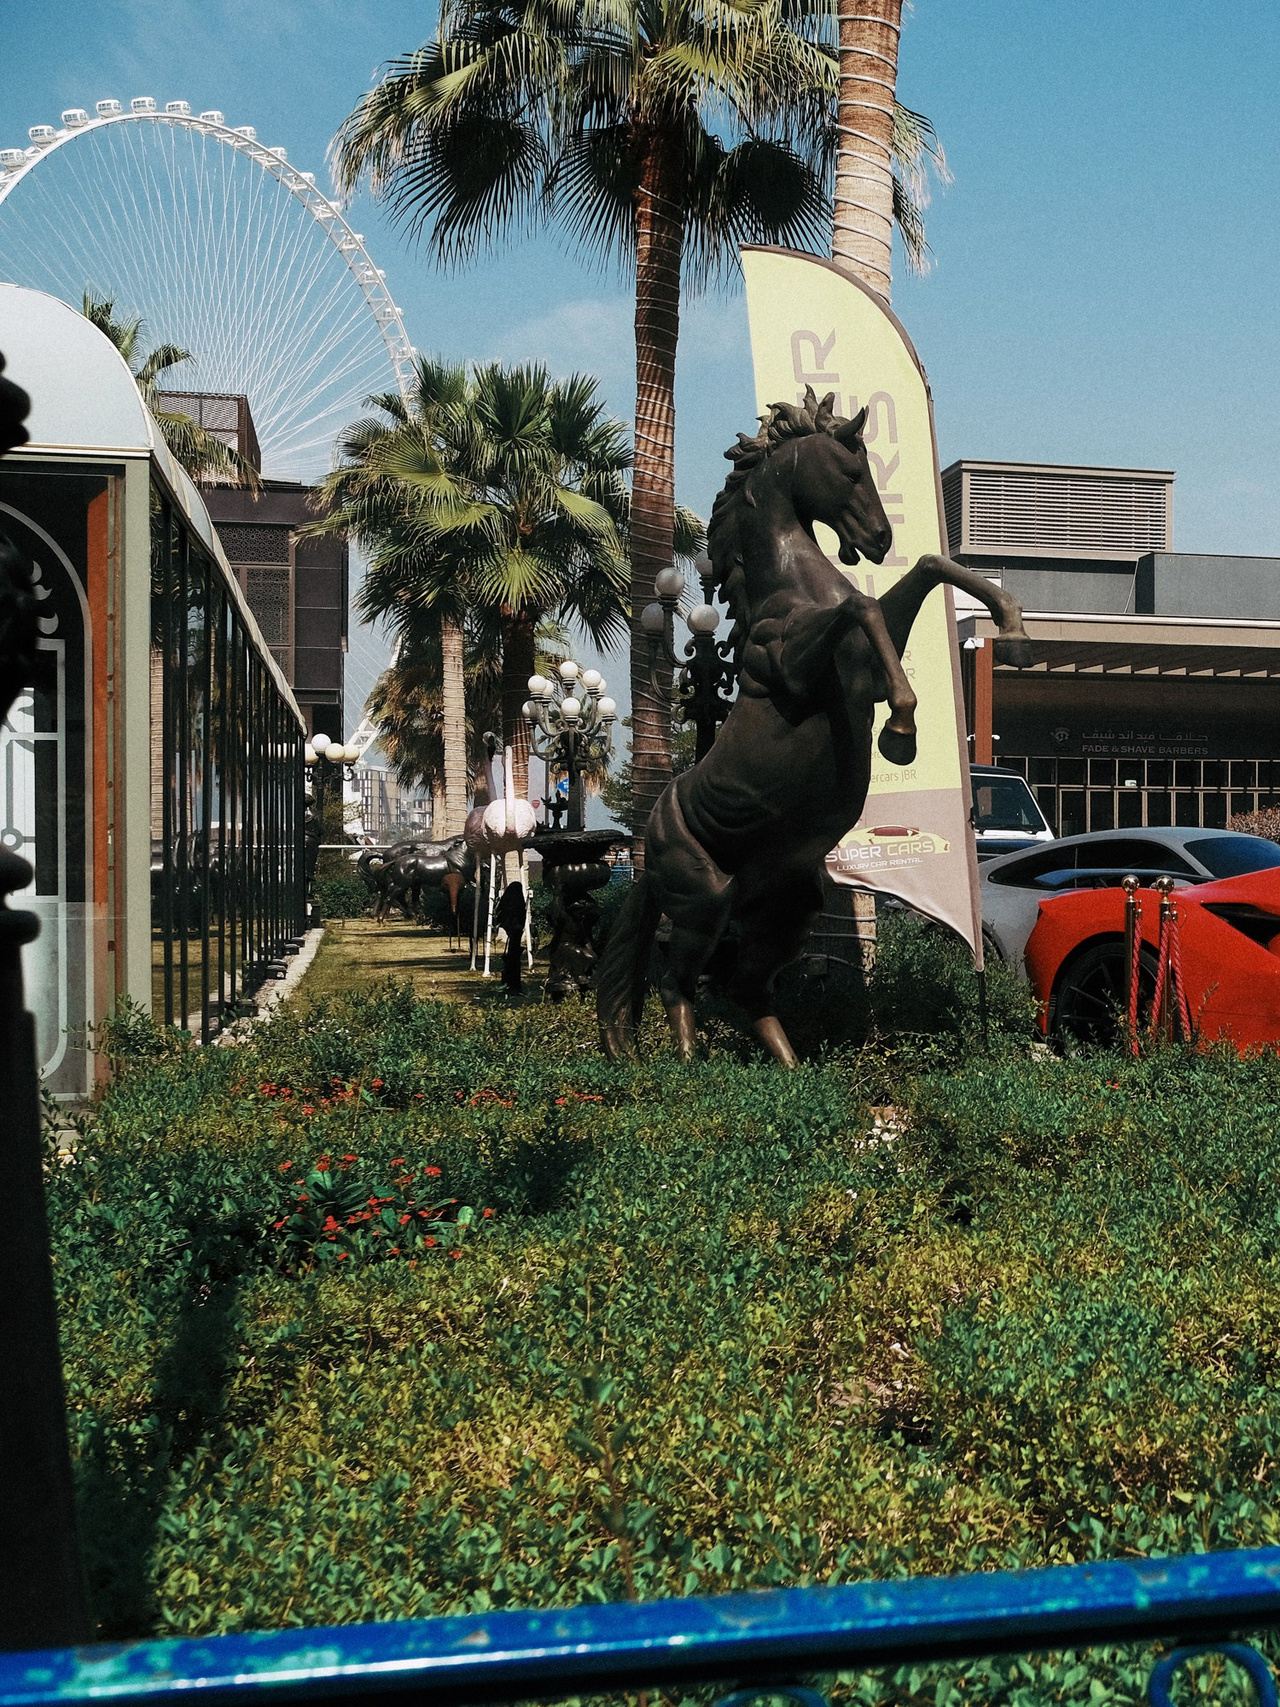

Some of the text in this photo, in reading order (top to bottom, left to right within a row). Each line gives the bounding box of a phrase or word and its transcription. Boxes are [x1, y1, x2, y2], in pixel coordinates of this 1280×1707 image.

[1082, 744, 1209, 755] FADE & SHAVE BARBERS
[825, 840, 934, 863] SUPER CARS
[836, 856, 924, 872] LUXURY CAR RENTAL
